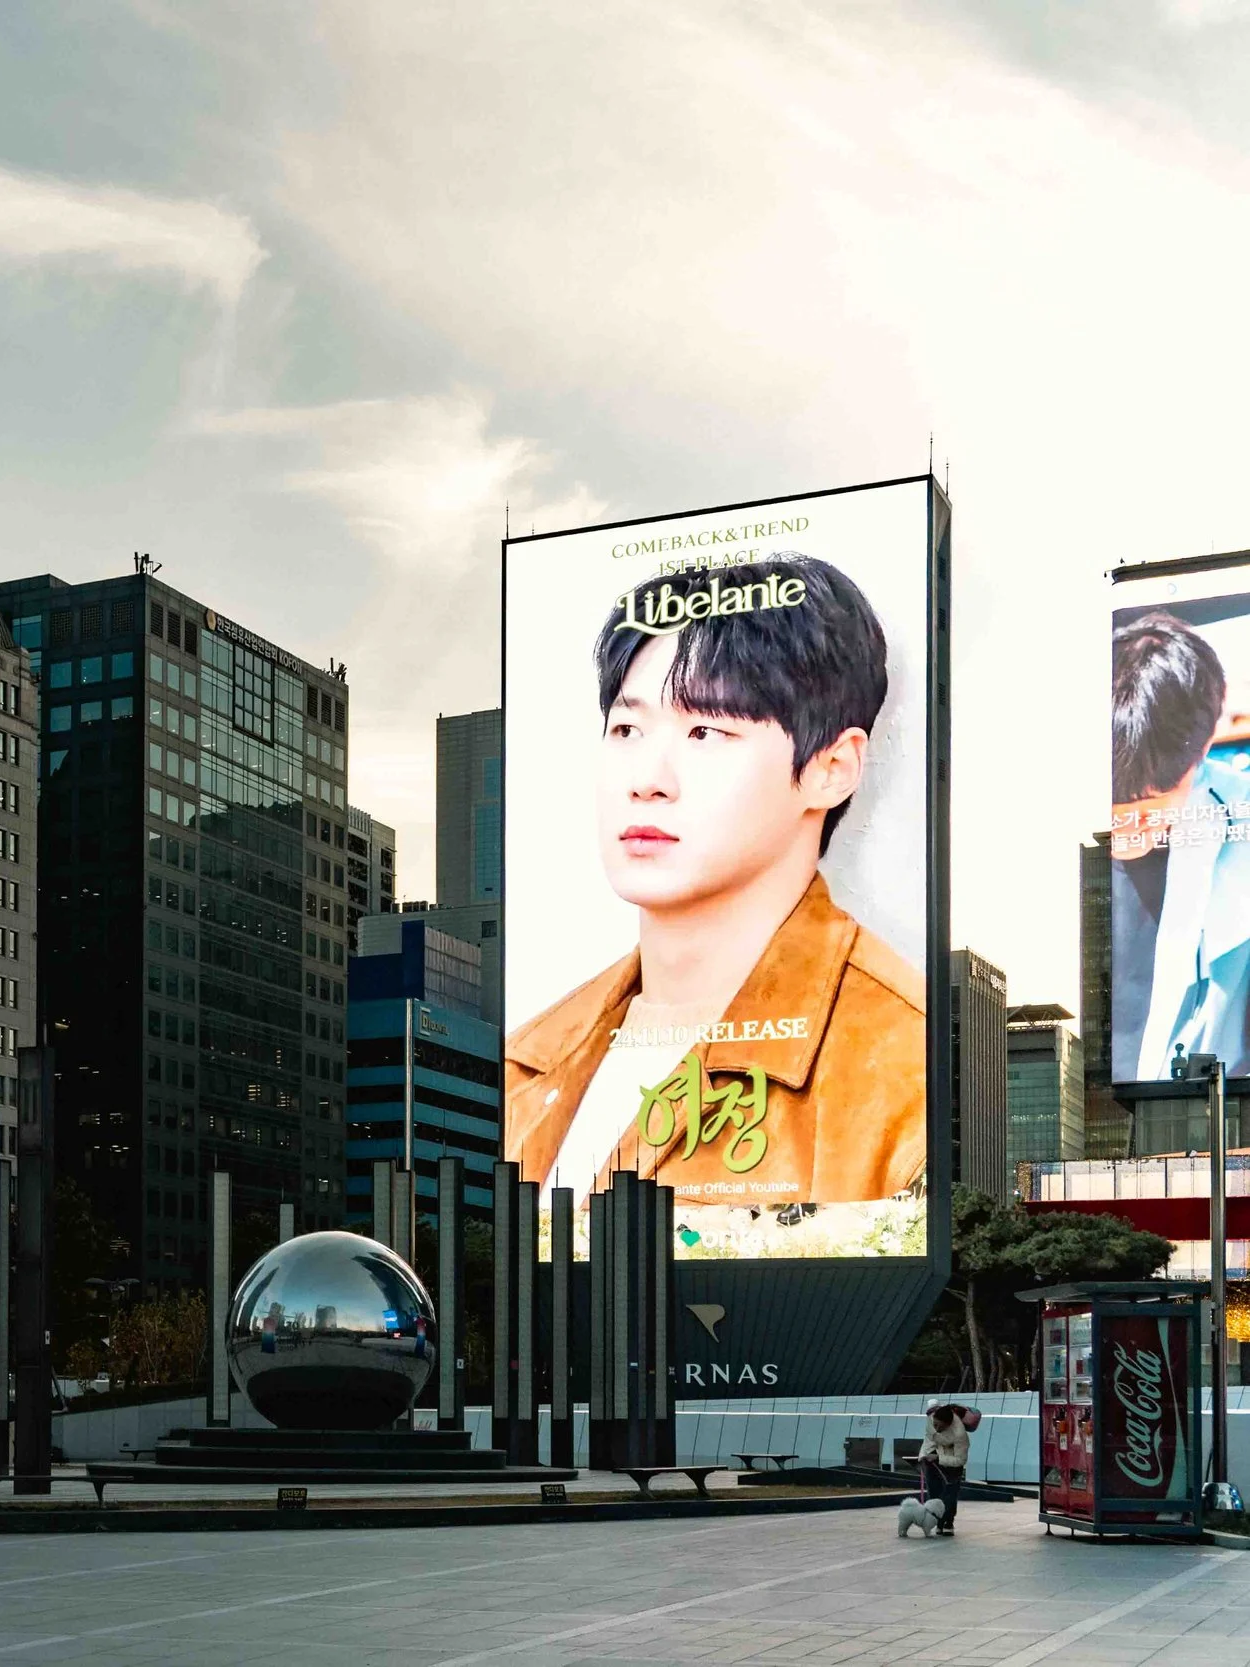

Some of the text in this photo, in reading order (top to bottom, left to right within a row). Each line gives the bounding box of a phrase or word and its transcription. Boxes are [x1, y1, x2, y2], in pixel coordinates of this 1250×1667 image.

[611, 516, 810, 560] COMEBACK&TREND
[658, 548, 761, 577] 1ST PLACE
[614, 572, 807, 637] Libelante
[1111, 831, 1146, 853] 들의
[609, 1017, 809, 1049] 24.11.10 RELEASE
[637, 1052, 769, 1174] 여정
[703, 1182, 746, 1195] Official
[749, 1181, 799, 1194] Youtube
[674, 1362, 779, 1387] RNAS
